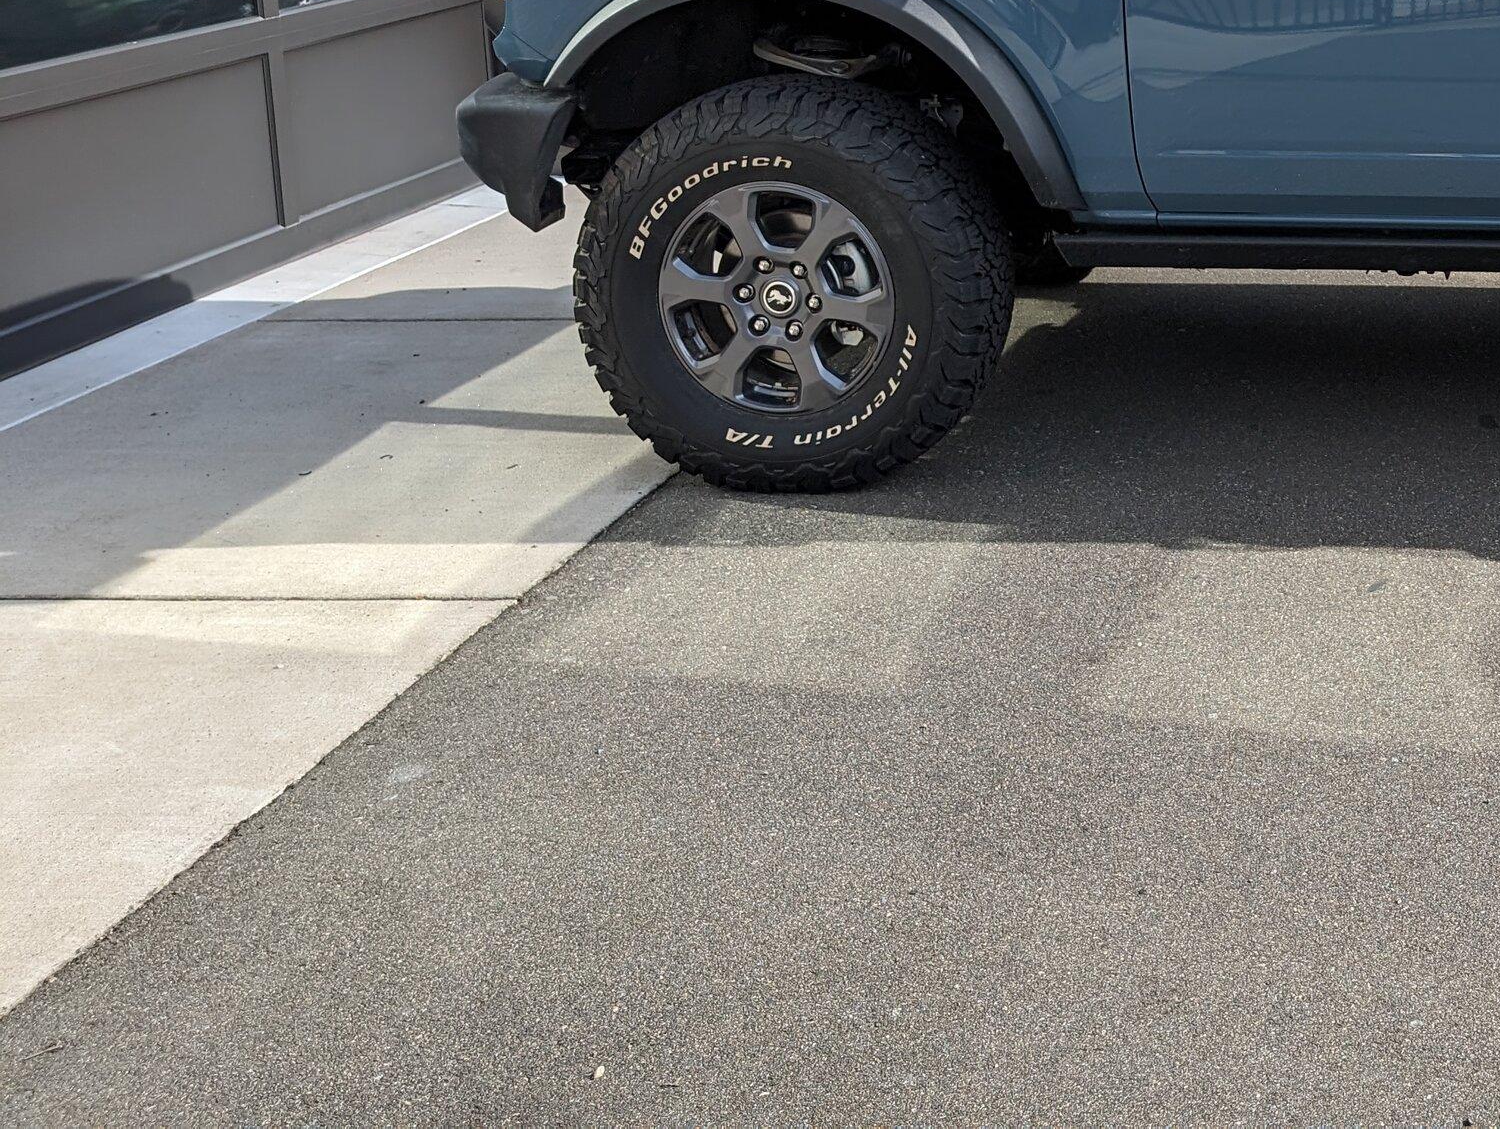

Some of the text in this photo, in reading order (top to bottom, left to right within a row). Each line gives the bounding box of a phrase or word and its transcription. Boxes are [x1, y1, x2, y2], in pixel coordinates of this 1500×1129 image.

[629, 155, 793, 260] BFGoodrich
[725, 324, 917, 449] All-Terrain T/A
